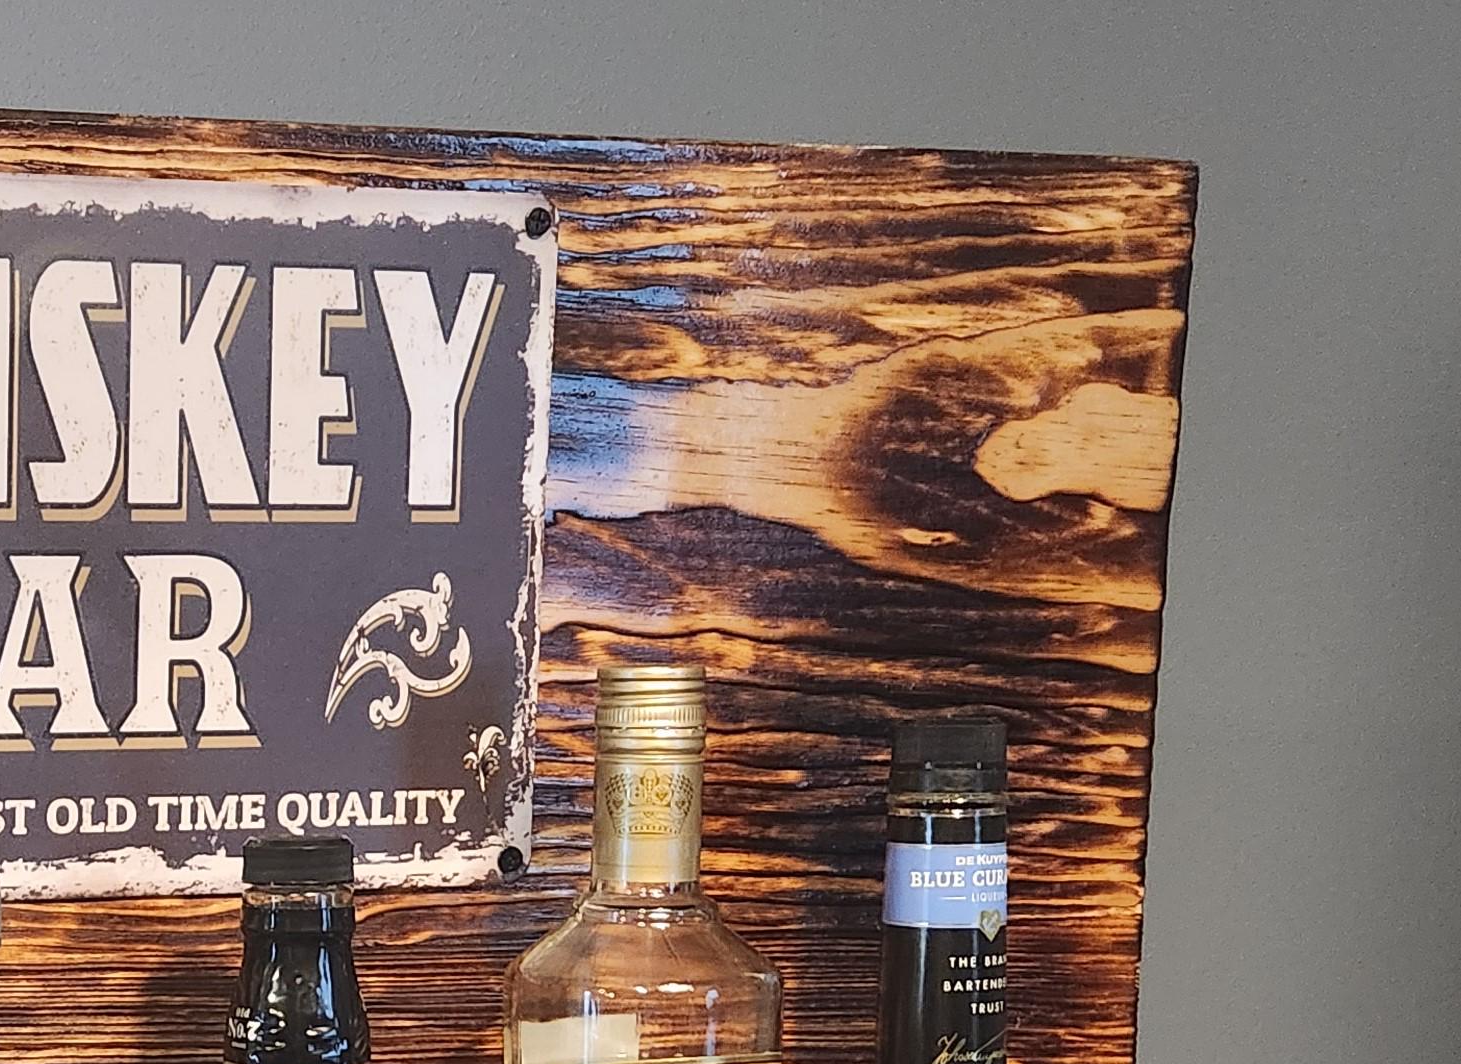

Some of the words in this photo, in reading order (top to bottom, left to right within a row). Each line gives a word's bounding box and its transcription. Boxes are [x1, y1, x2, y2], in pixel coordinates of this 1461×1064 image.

[46, 795, 138, 834] OLD
[147, 792, 265, 831] TIME
[276, 788, 465, 834] QUALITY
[955, 855, 975, 866] DE
[910, 871, 965, 888] BLUE
[949, 956, 977, 969] THE
[970, 1001, 1004, 1015] TRUST
